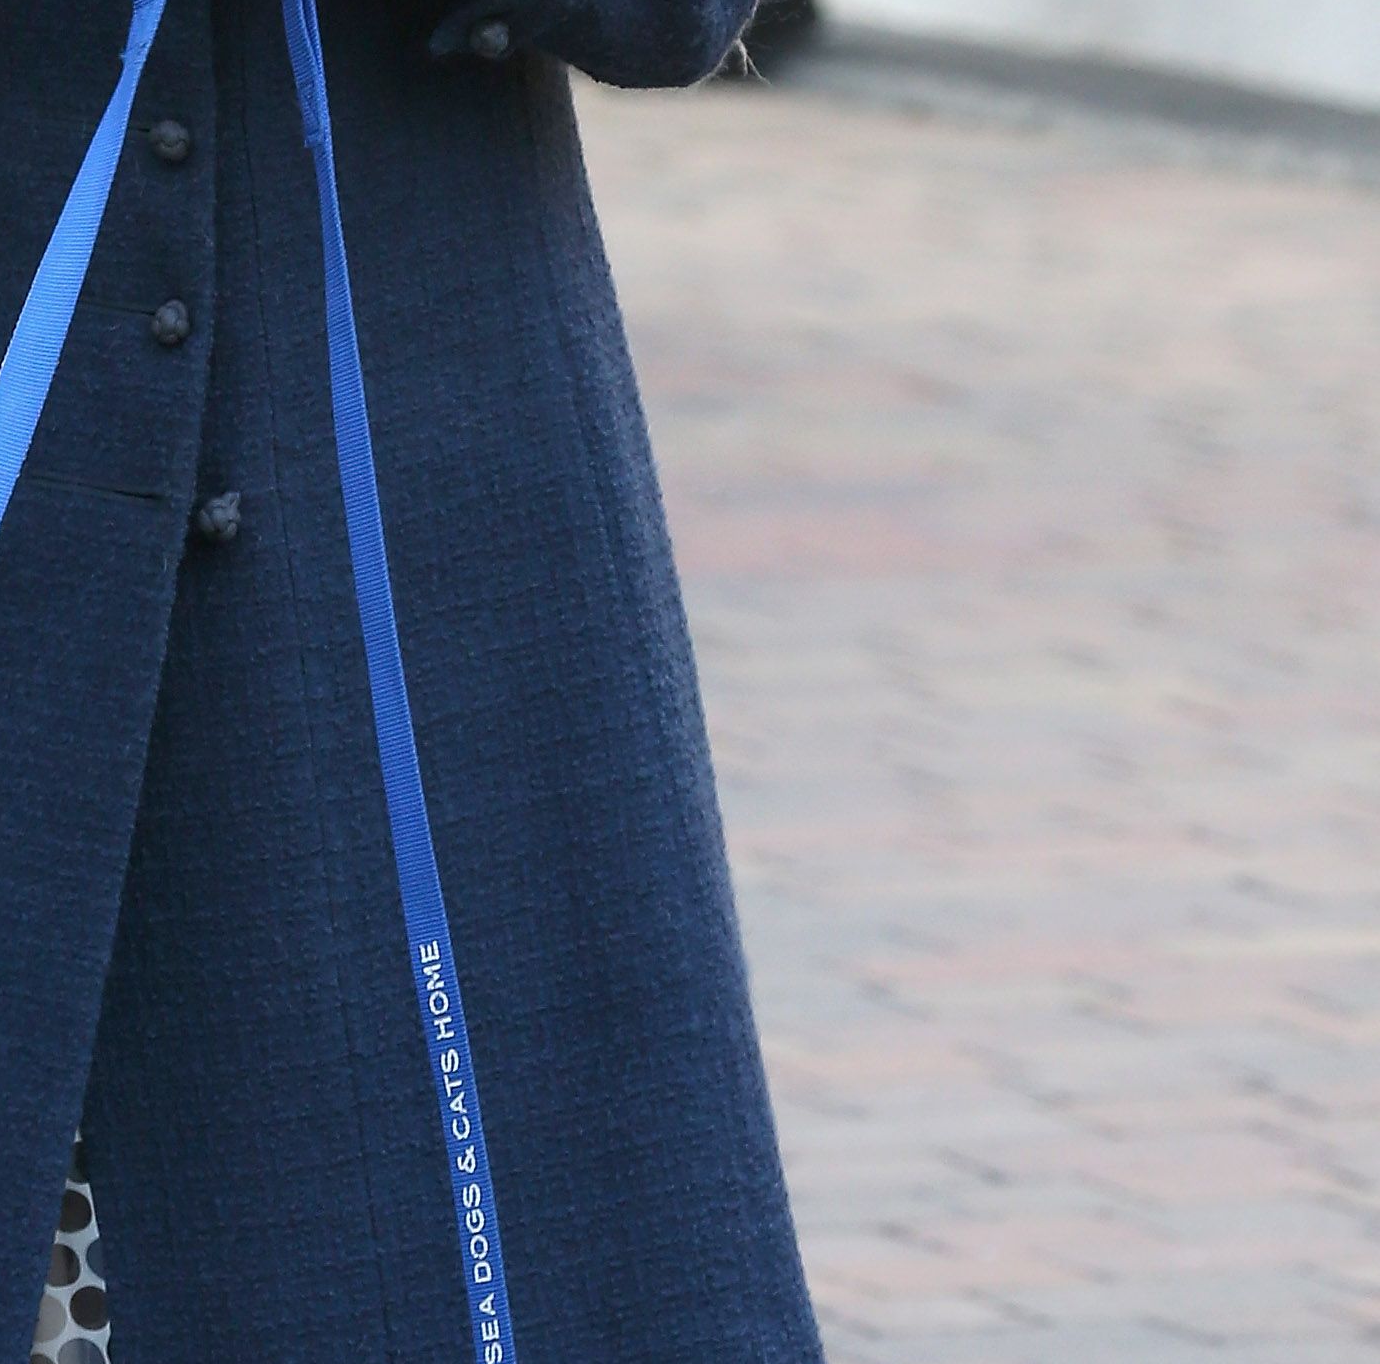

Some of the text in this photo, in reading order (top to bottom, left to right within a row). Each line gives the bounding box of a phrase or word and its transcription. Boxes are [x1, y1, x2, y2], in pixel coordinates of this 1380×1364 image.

[418, 940, 456, 1041] HOME
[440, 1048, 471, 1140] CATS
[456, 1144, 477, 1174] &
[462, 1183, 493, 1284] DOGS
